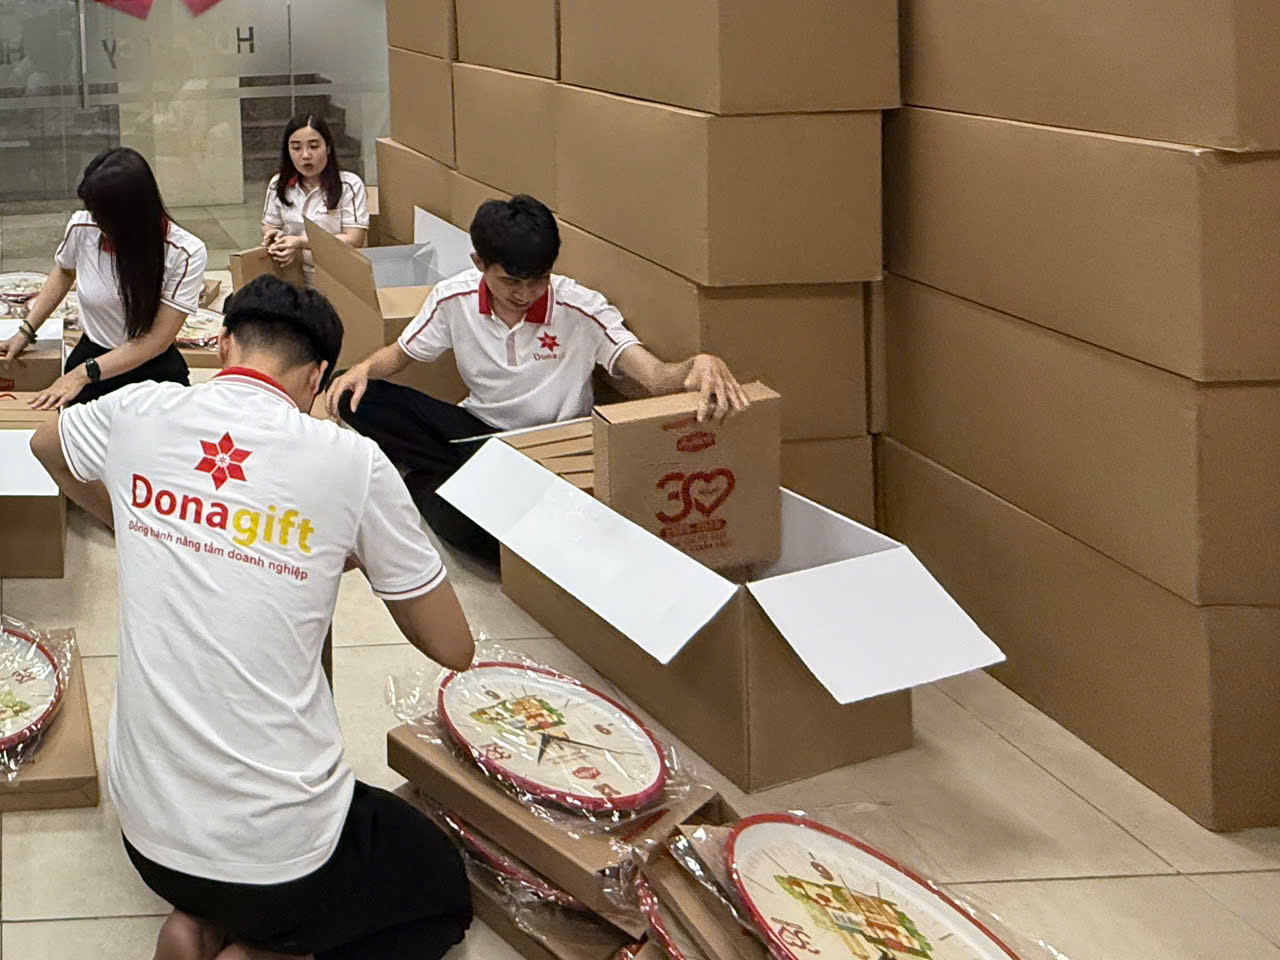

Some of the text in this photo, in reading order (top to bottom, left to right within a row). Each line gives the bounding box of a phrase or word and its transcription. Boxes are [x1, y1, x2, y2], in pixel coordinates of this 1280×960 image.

[131, 473, 315, 554] Donagift
[227, 549, 264, 568] doanh
[268, 561, 308, 581] nghiệp
